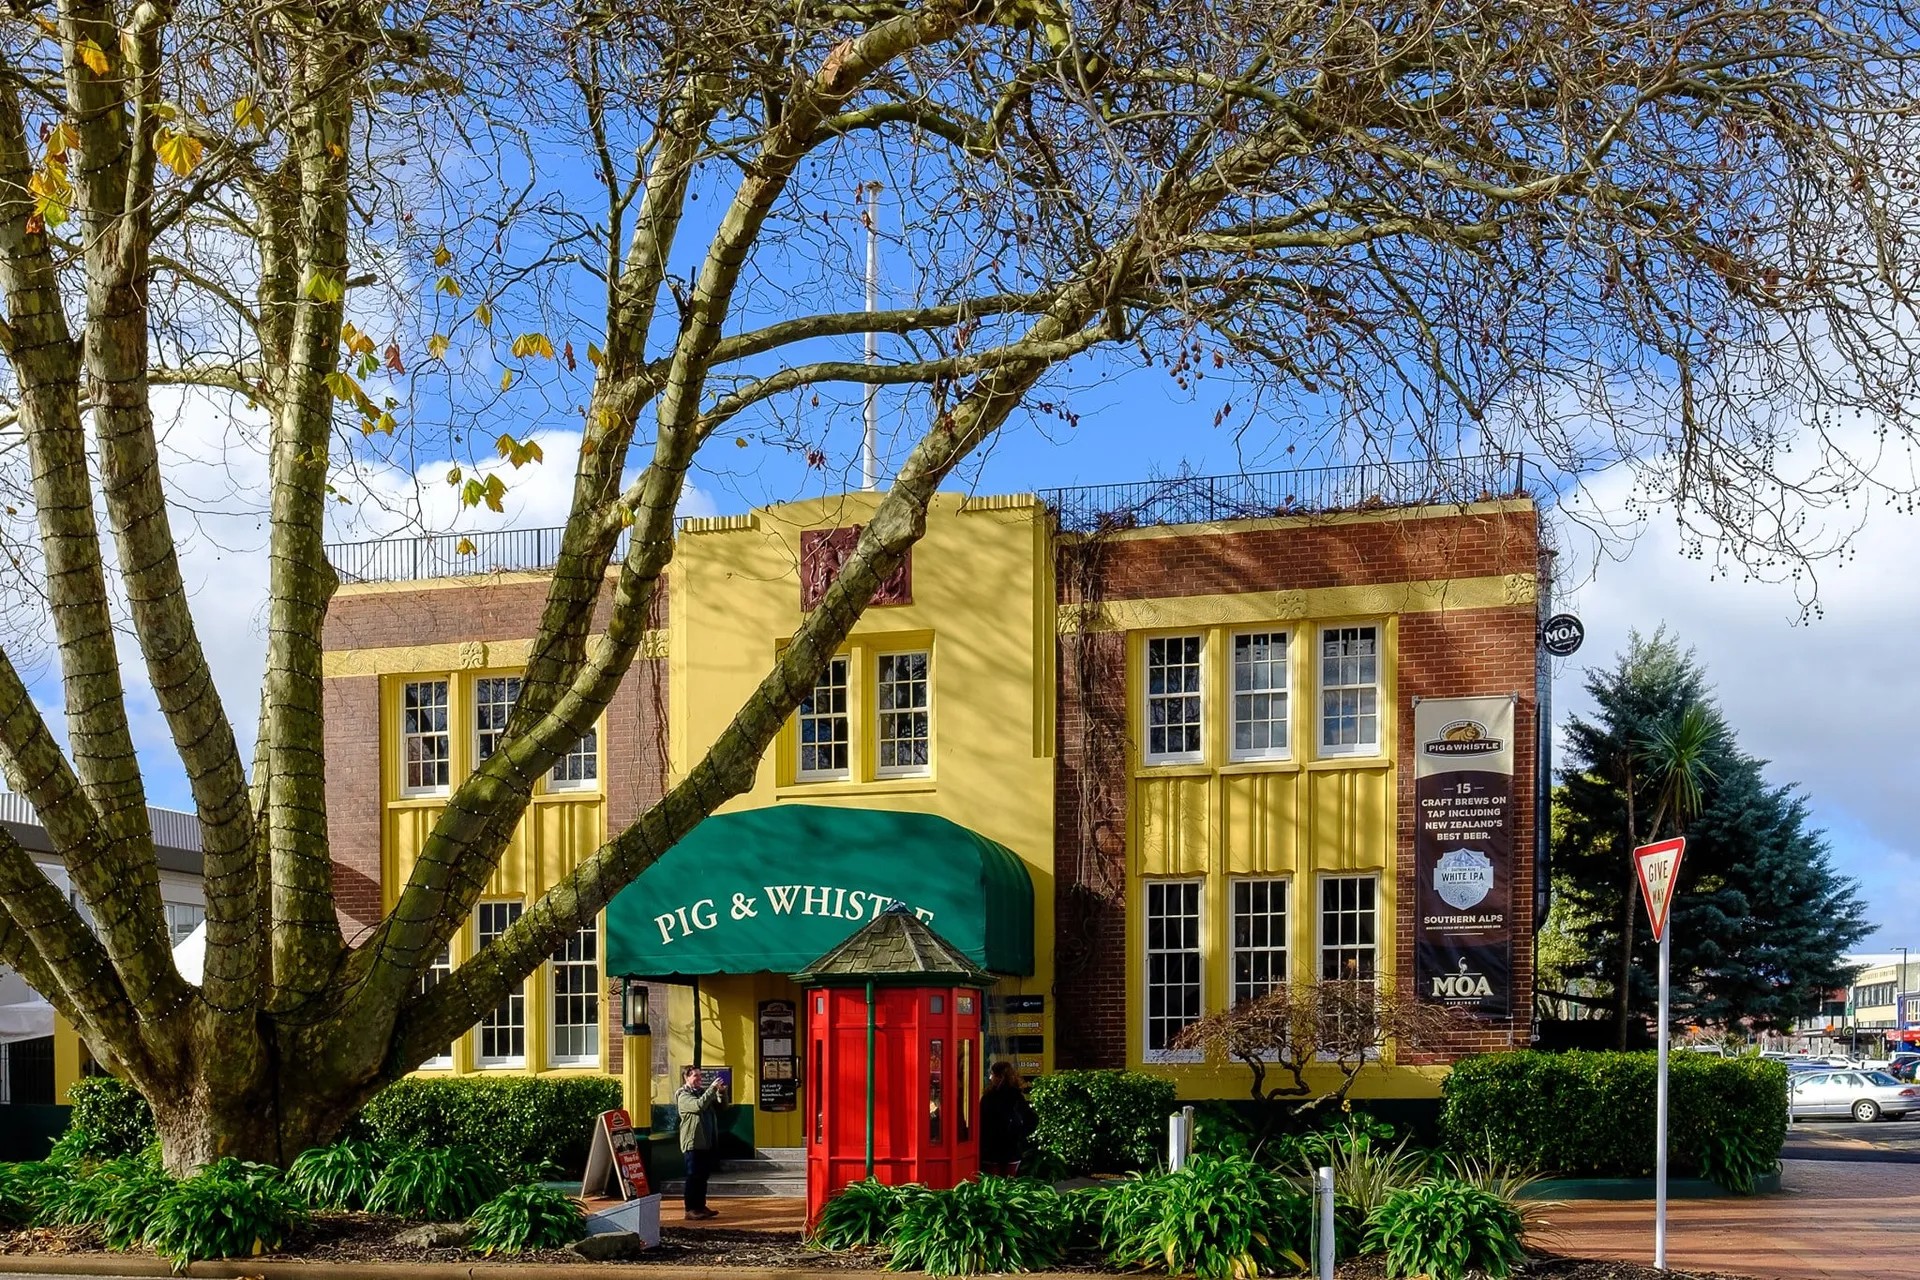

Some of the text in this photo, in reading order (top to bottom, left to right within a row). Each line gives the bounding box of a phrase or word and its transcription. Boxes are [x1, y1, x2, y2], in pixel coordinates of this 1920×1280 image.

[1544, 625, 1581, 644] MOA
[1428, 742, 1499, 752] PIG&WHISTLE
[1456, 783, 1471, 794] 15
[1421, 796, 1507, 807] CRAFT BREWS ON
[1428, 808, 1501, 818] TAP INCLUDING
[1425, 819, 1503, 830] NEW ZEALAND'S
[1437, 831, 1491, 841] BEST BEER.
[1648, 860, 1668, 882] GIVE
[1441, 872, 1467, 882] WHITE
[1652, 887, 1665, 904] WAY
[654, 885, 934, 945] PIG & WHISTE
[1424, 914, 1503, 924] SOUTHERN ALPS
[1431, 976, 1494, 997] MOA
